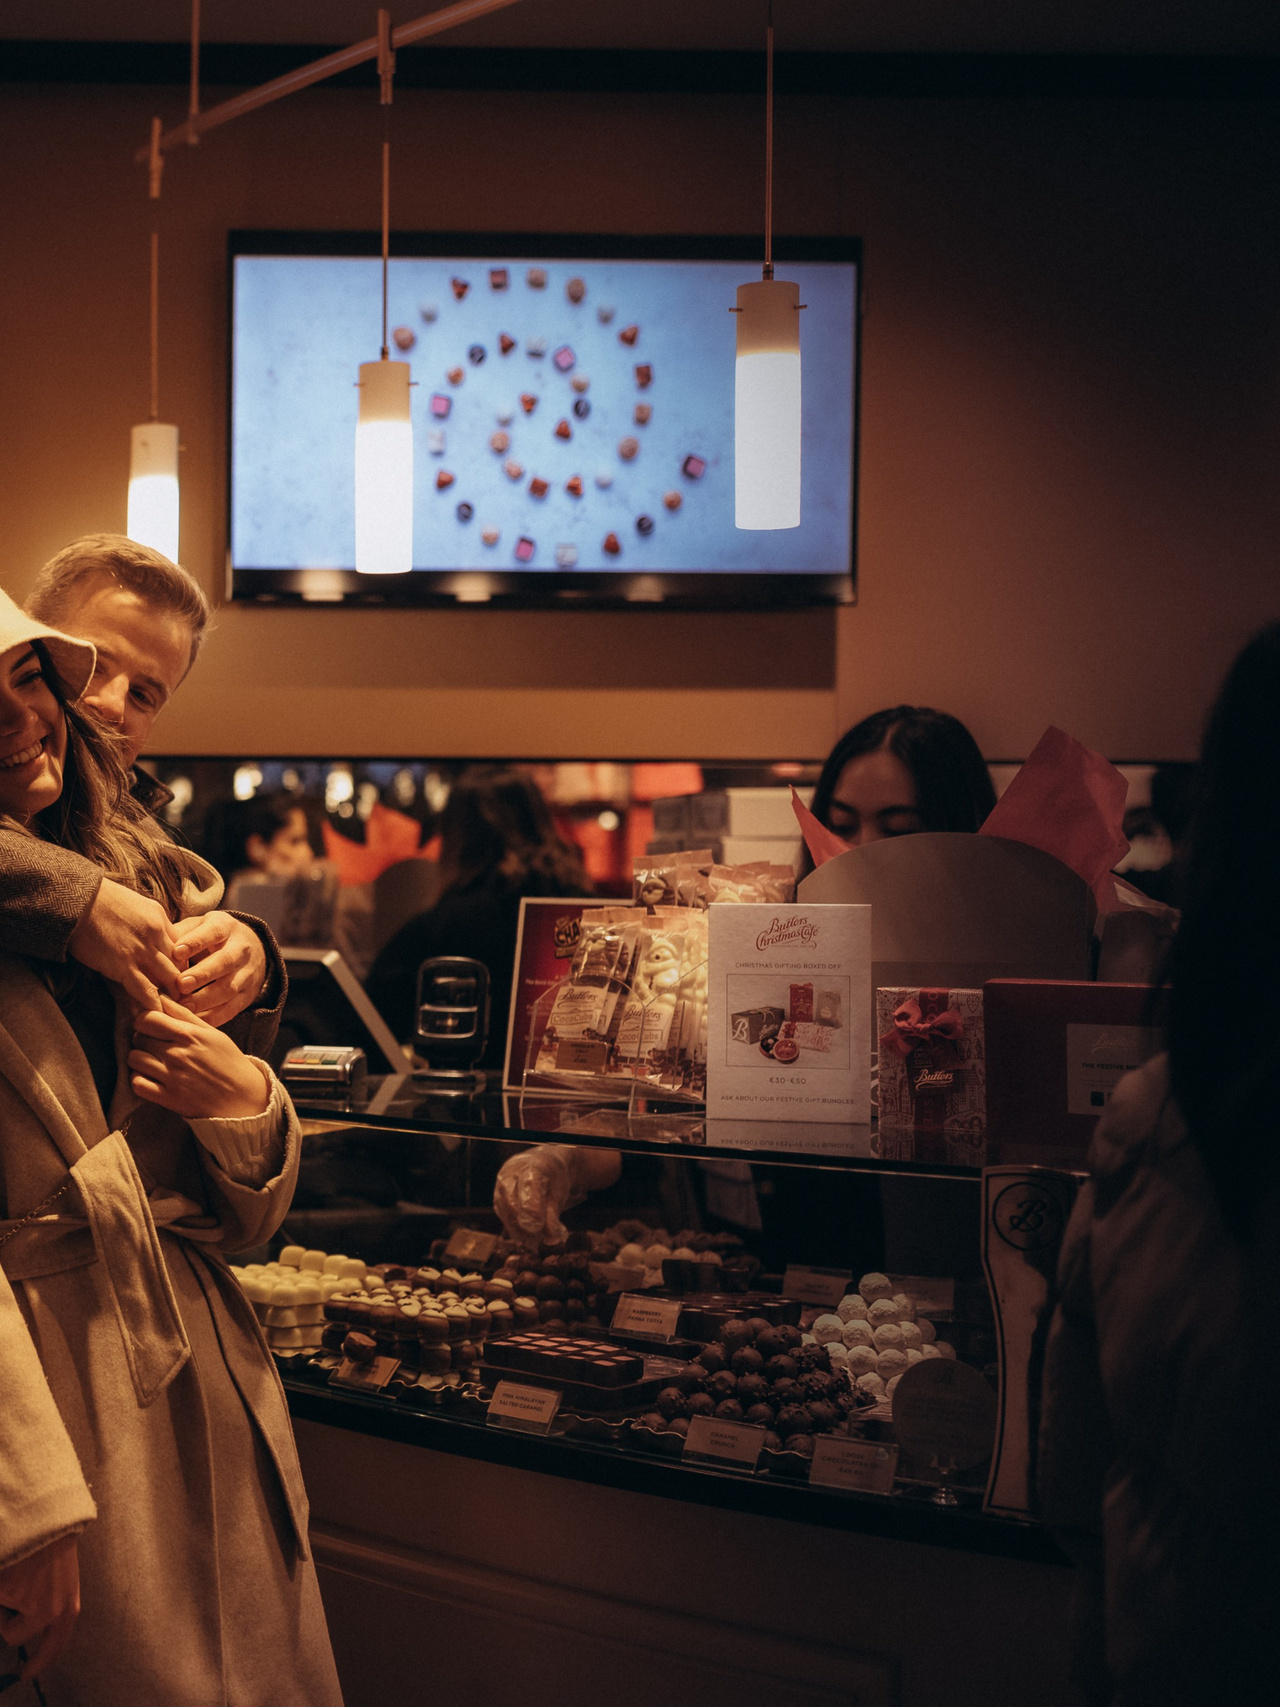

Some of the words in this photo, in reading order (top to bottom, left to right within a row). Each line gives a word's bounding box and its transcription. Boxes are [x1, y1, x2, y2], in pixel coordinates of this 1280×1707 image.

[556, 918, 582, 944] CHA
[767, 915, 808, 935] Butlers
[756, 929, 801, 951] Christmas
[558, 988, 597, 1005] Butlers
[553, 1013, 594, 1023] CocoCubs
[914, 1069, 954, 1089] Butlers
[1009, 1200, 1047, 1232] B
[632, 1309, 661, 1317] RASPBERRY
[515, 1394, 546, 1405] HIMALAYAN
[499, 1400, 519, 1408] SALTED
[519, 1403, 543, 1412] CARAMEL
[710, 1431, 739, 1442] CARAMEL
[710, 1439, 736, 1448] CRUNCH
[821, 1455, 869, 1467] CHOCOLATES
[841, 1451, 864, 1460] LOOSE
